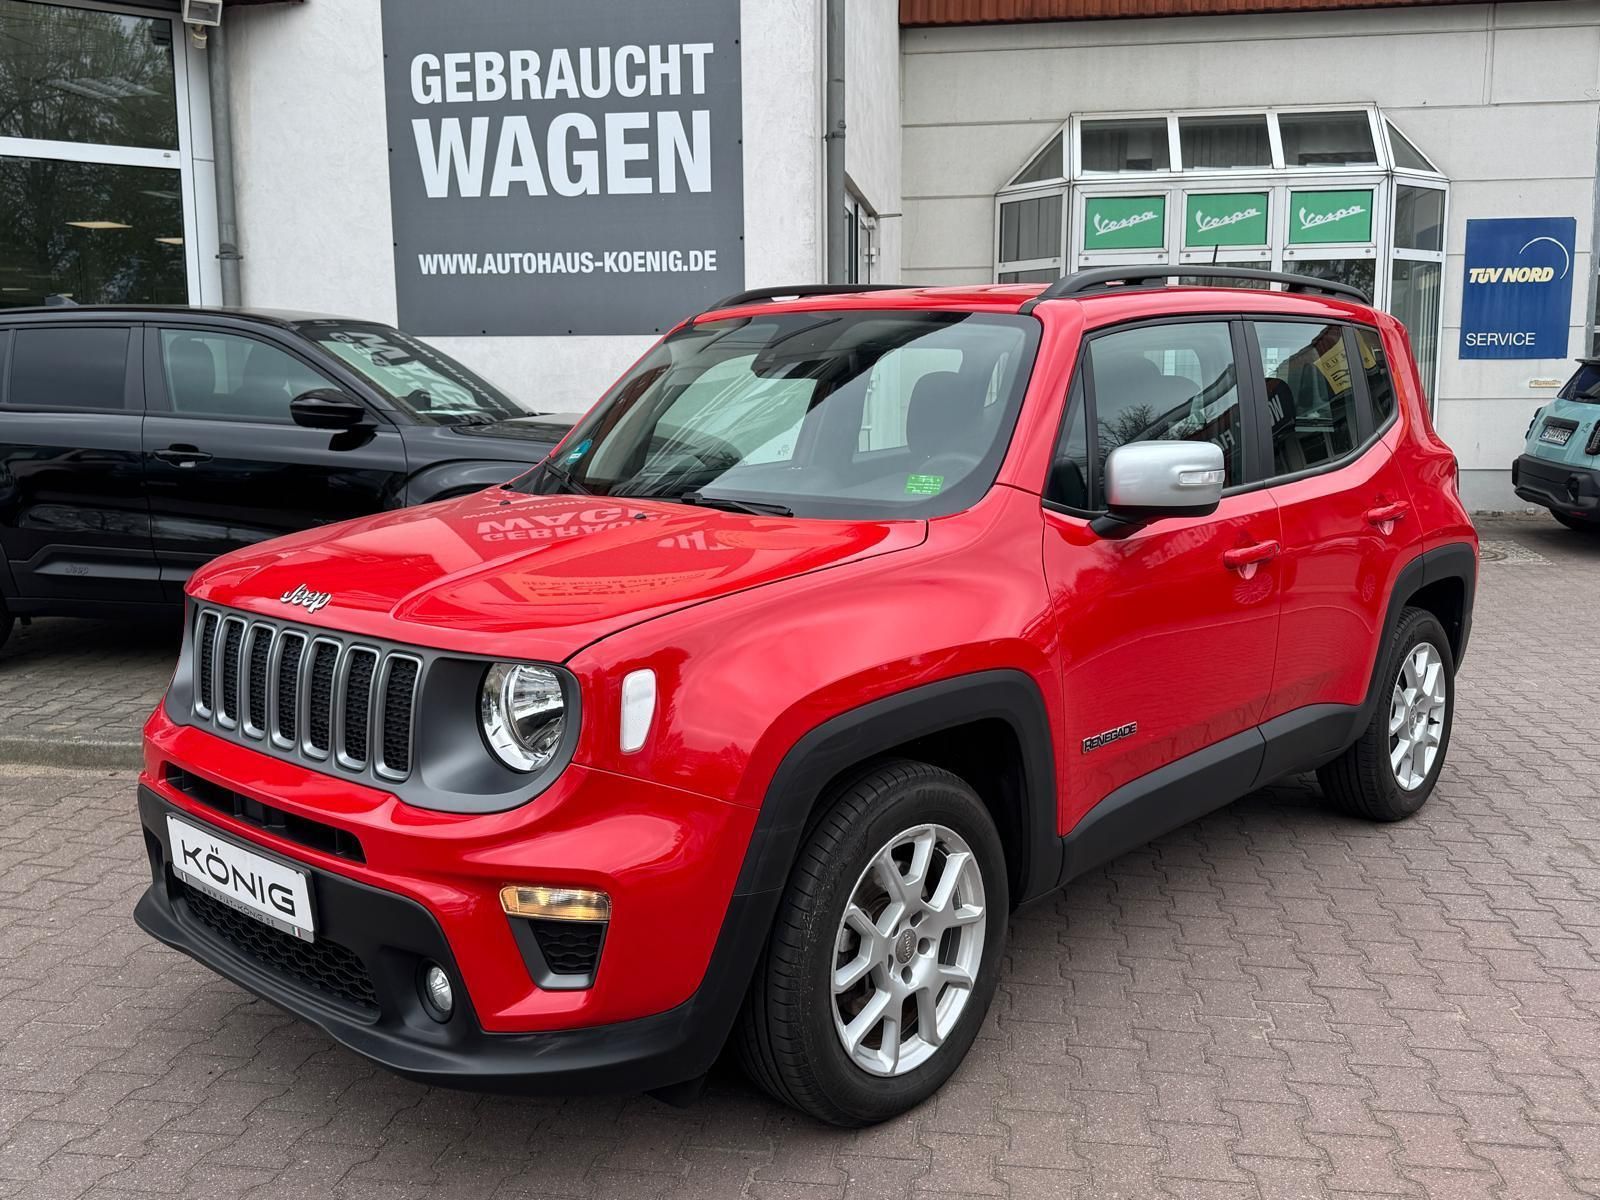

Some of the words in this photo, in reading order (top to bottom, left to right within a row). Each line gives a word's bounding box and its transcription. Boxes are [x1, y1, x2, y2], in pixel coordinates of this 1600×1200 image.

[410, 43, 714, 104] GEBRAUCHT
[411, 110, 712, 198] WAGEN
[1094, 211, 1159, 236] Vespa
[1195, 207, 1262, 233] Vespa
[1299, 205, 1366, 230] Vespa
[418, 250, 718, 275] WWW.AUTOHAUS-KOENIG.DE
[1469, 268, 1501, 284] TÜV
[1502, 267, 1555, 283] NORD
[1465, 332, 1537, 346] SERVICE
[280, 583, 332, 614] Jeep
[1083, 721, 1137, 753] RENEGADE
[181, 839, 296, 918] KÖNIG
